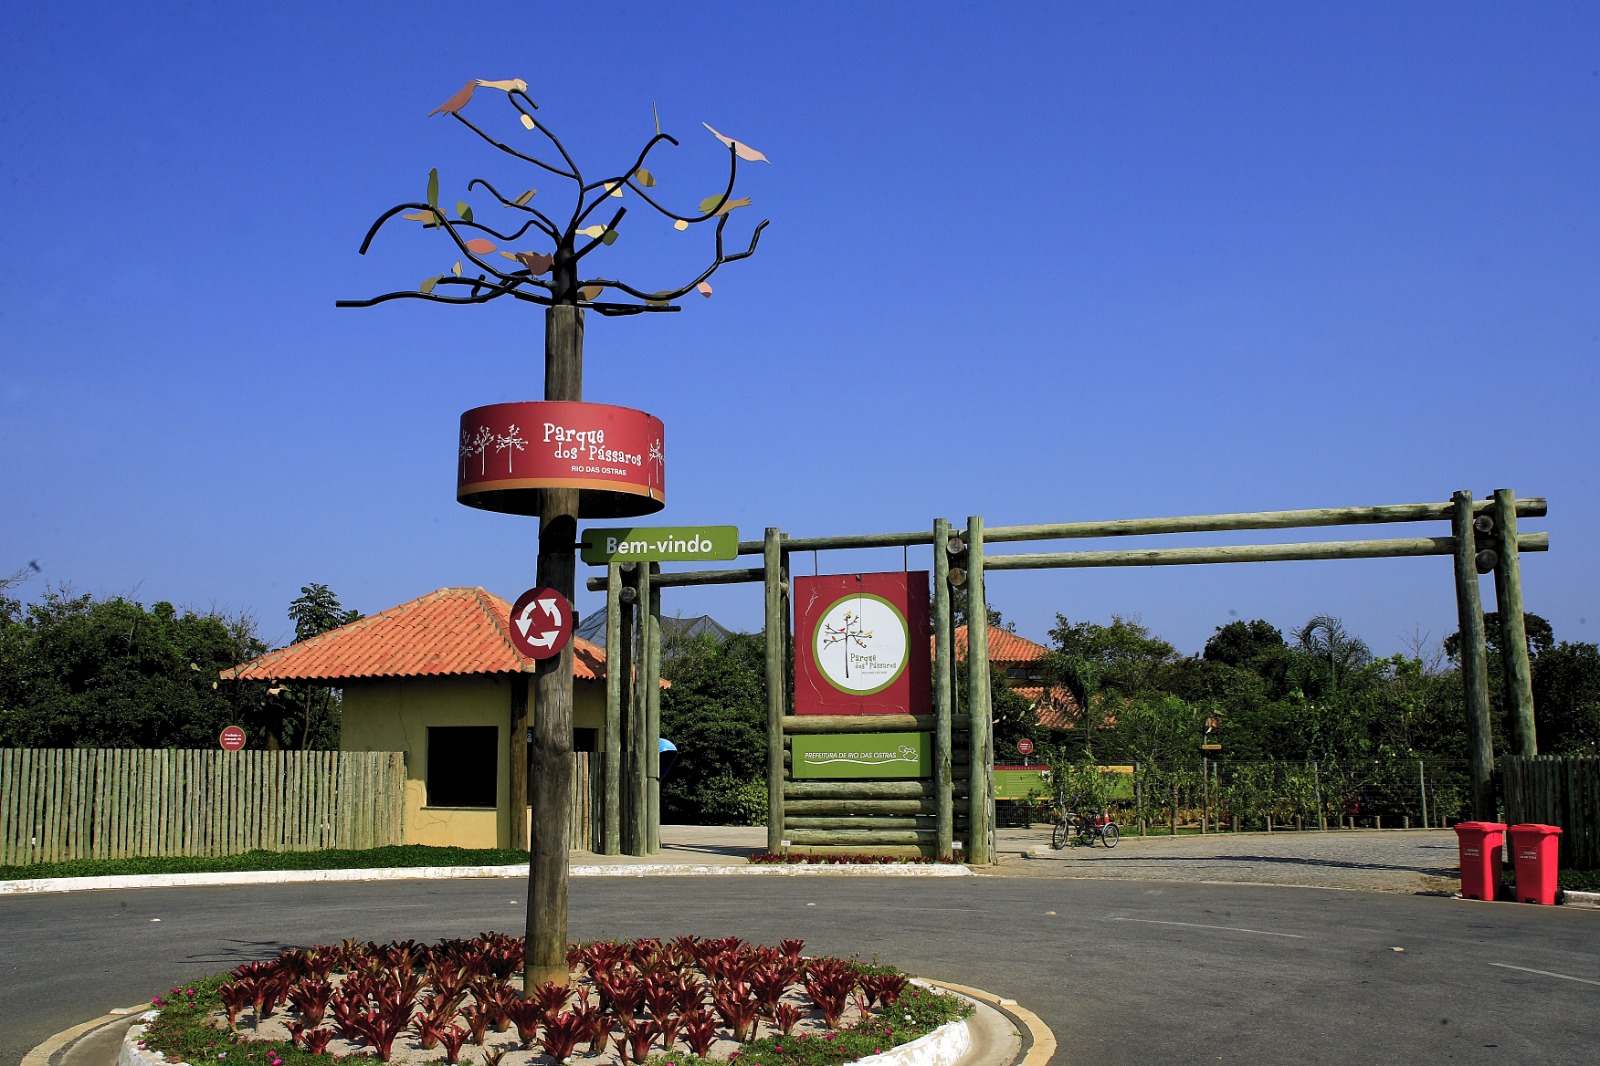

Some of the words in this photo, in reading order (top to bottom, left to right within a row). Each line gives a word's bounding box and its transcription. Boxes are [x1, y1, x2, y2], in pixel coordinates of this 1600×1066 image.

[543, 423, 604, 451] Parque
[554, 442, 578, 460] dos
[589, 445, 642, 467] Pássaros
[571, 465, 585, 473] RIO
[585, 466, 600, 474] DAS
[601, 467, 627, 476] OSTRAS
[606, 534, 713, 554] Bem-vindo
[850, 653, 877, 665] Parque
